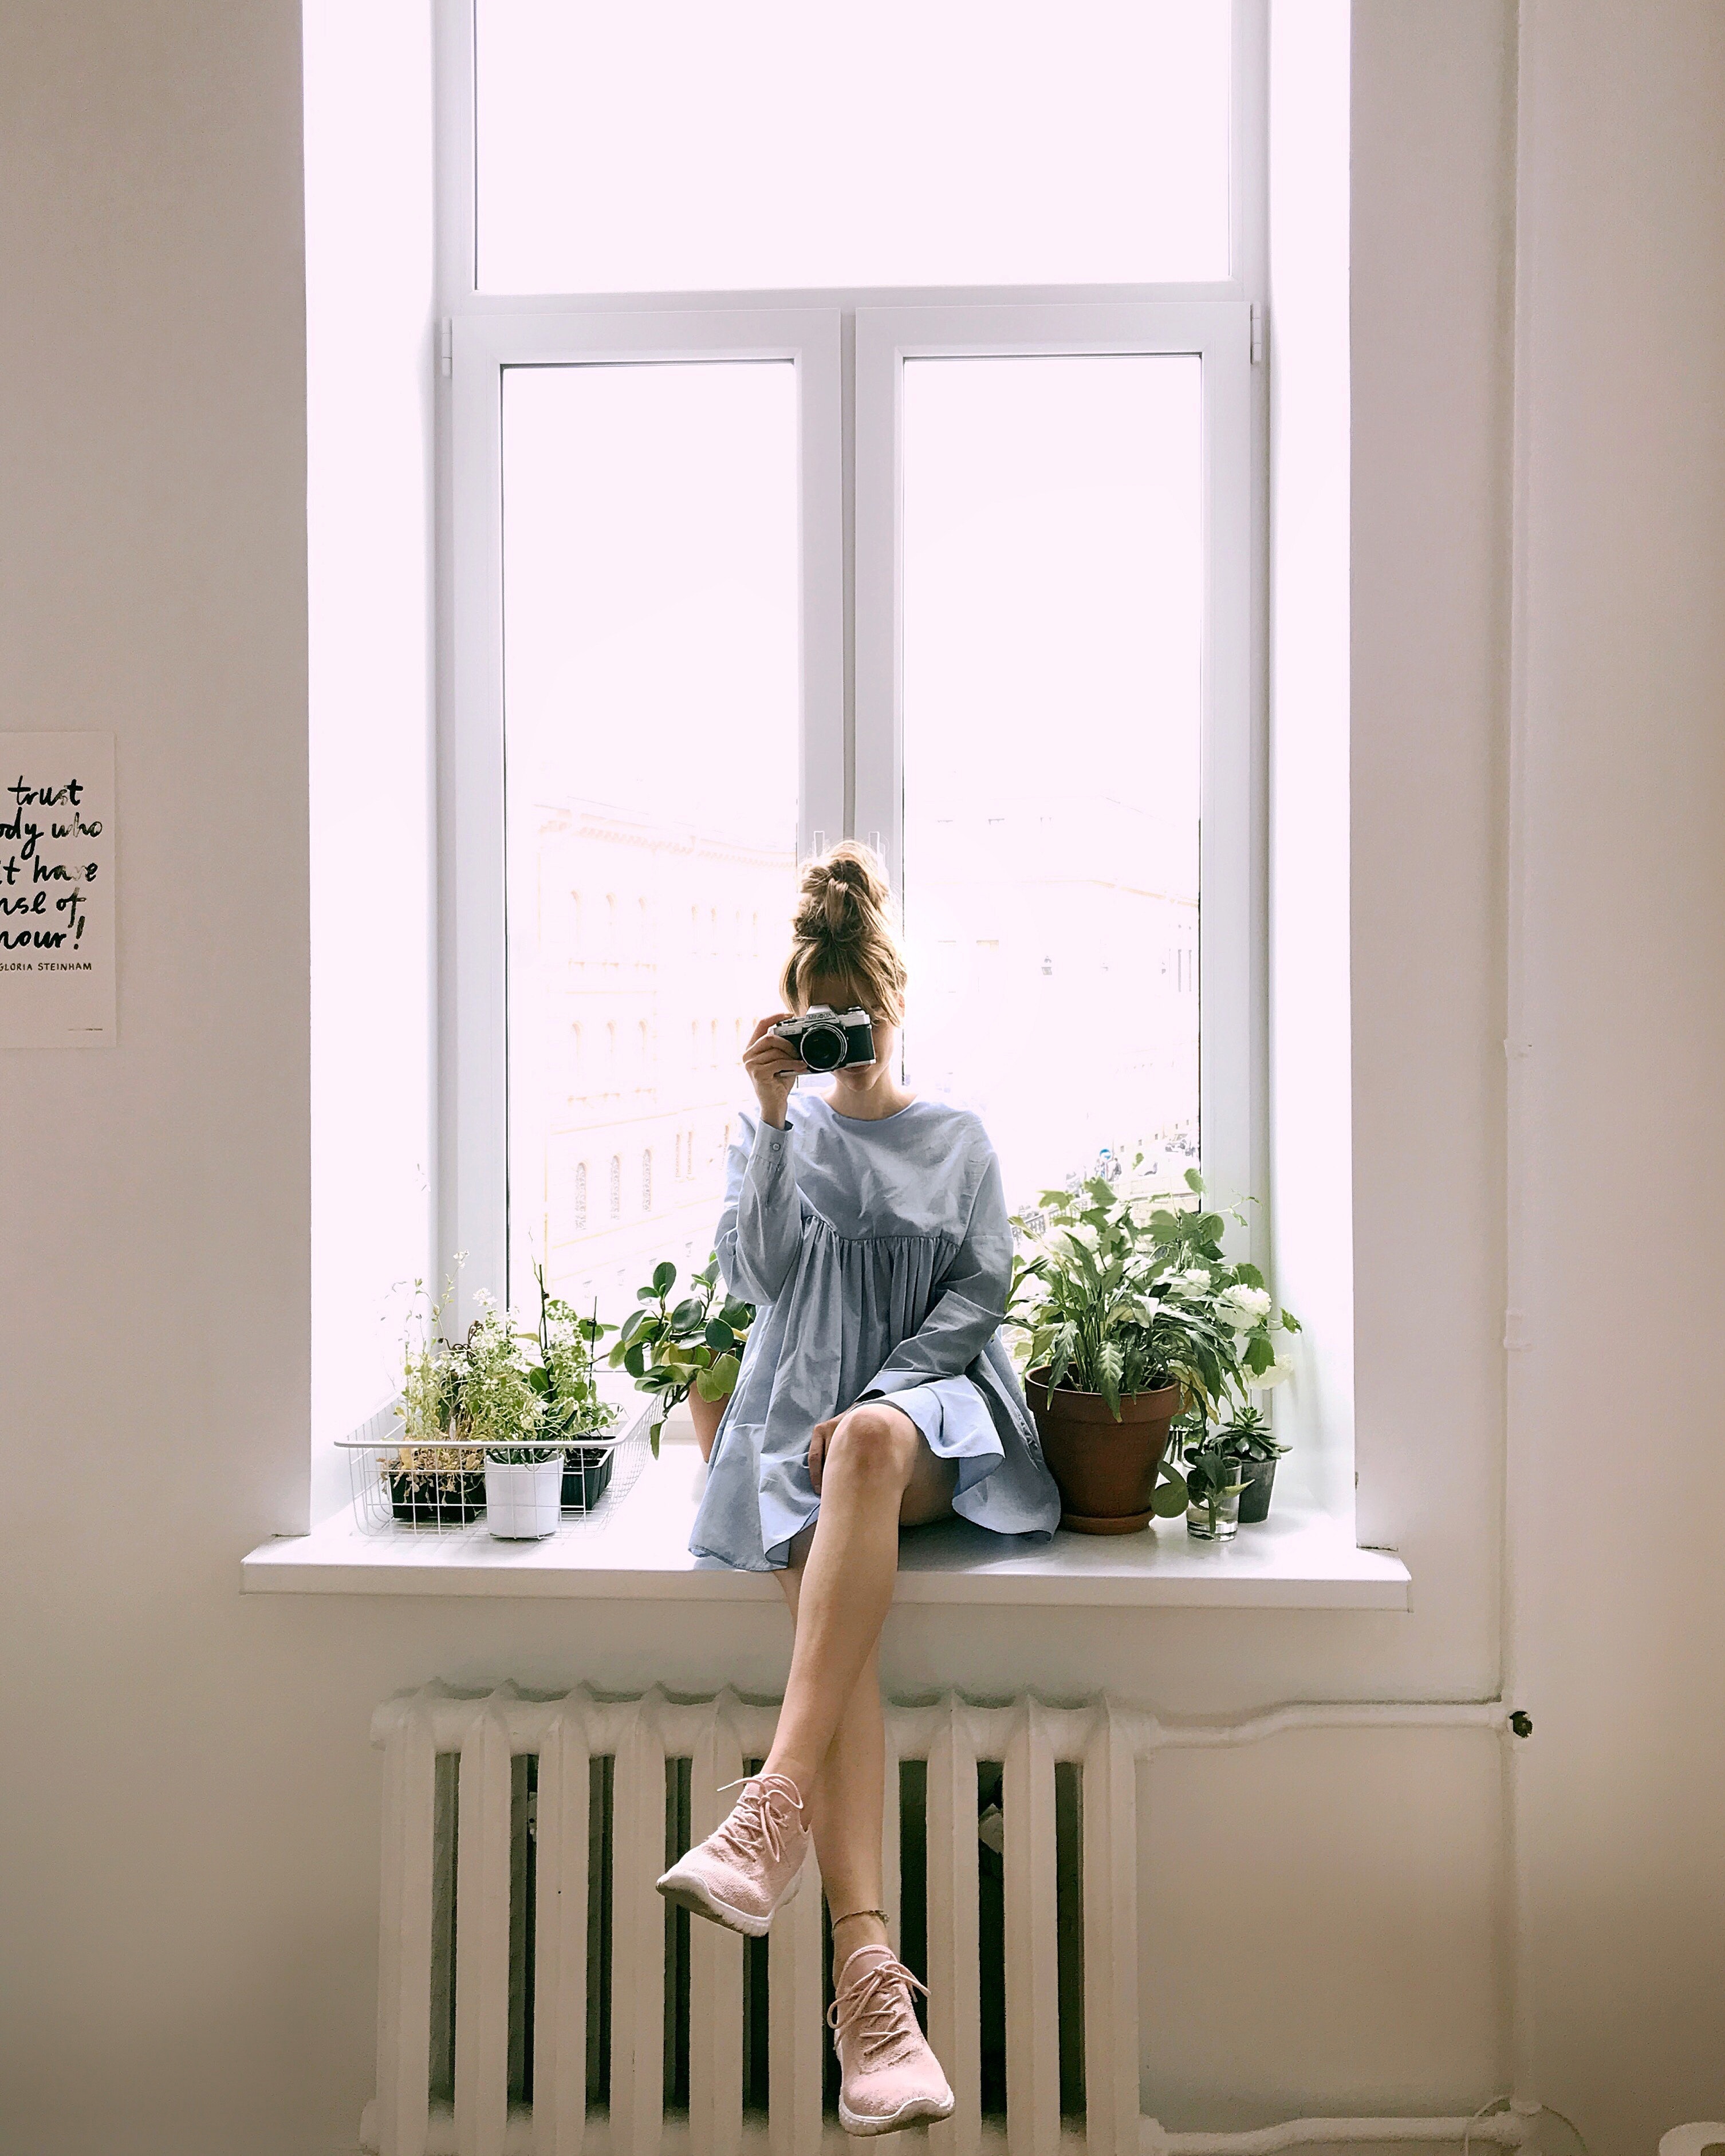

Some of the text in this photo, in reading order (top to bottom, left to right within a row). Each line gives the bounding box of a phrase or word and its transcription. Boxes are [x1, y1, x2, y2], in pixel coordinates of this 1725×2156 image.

[7, 775, 83, 806] trust
[52, 811, 103, 838] who
[33, 855, 98, 883] have
[56, 887, 87, 928] of
[0, 962, 92, 971] GLORIA STEINHAM
